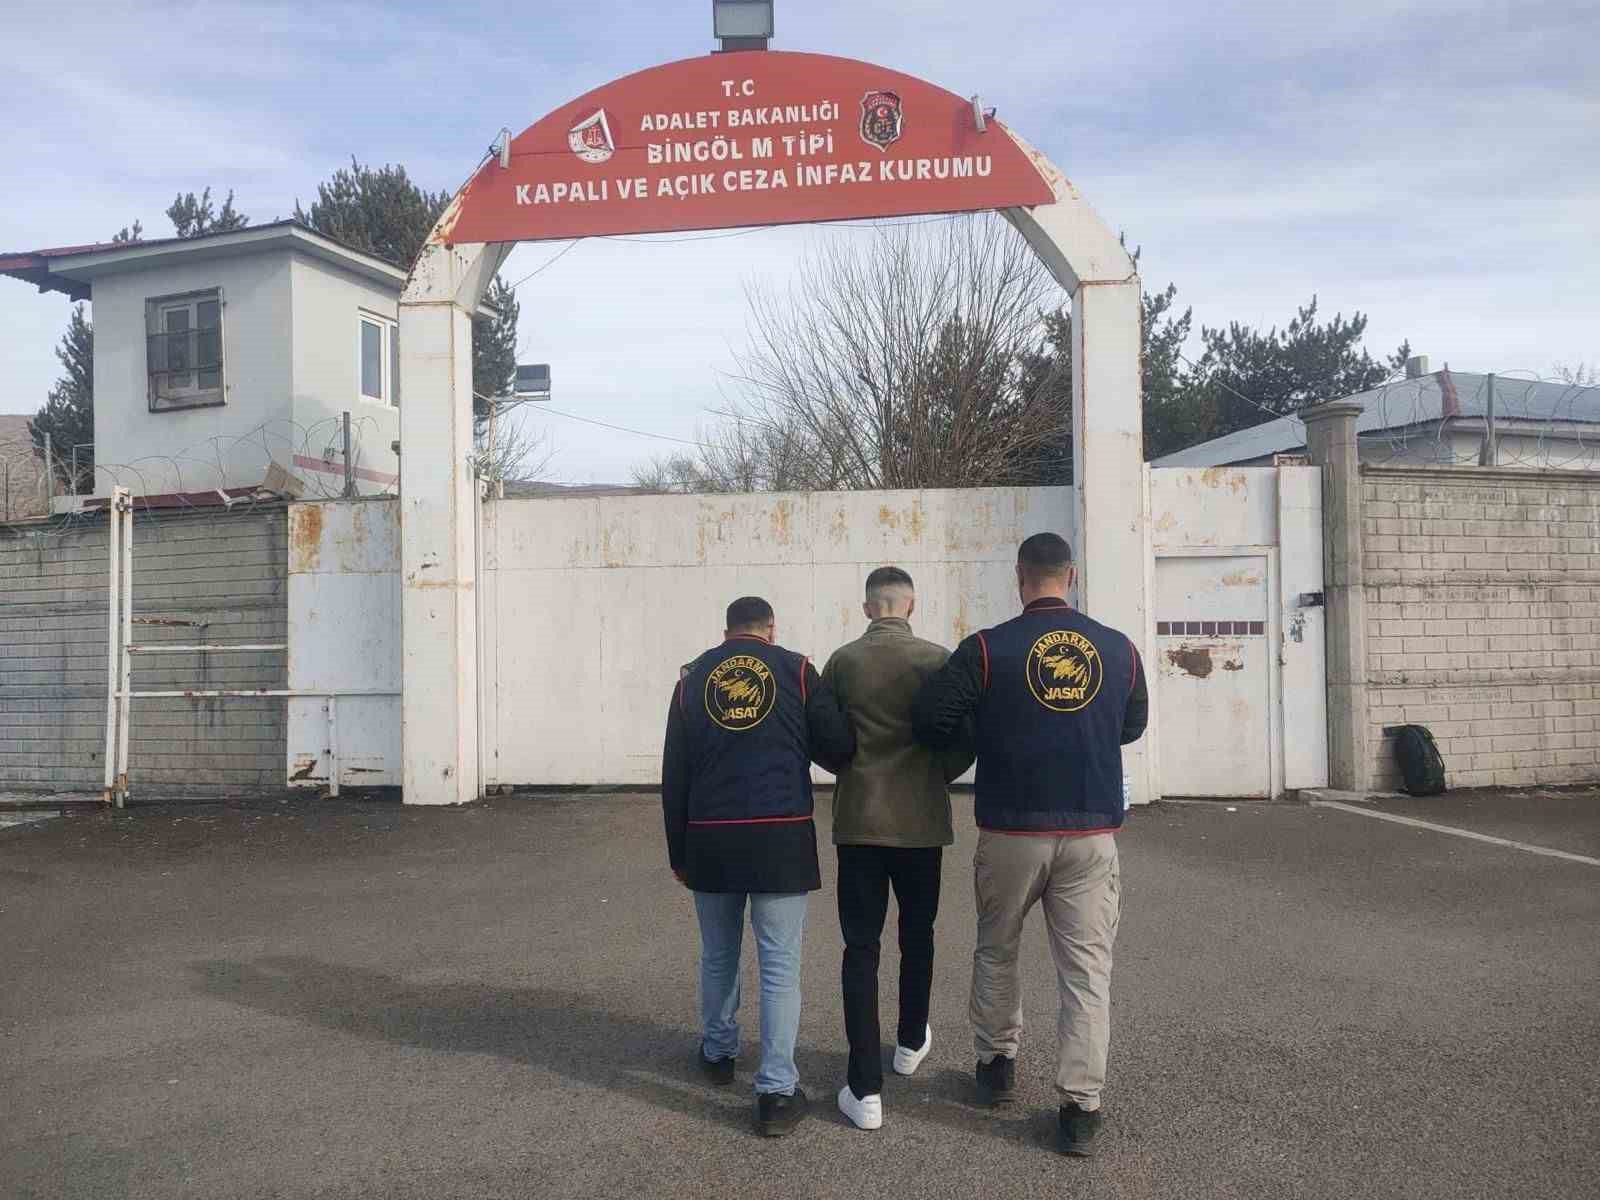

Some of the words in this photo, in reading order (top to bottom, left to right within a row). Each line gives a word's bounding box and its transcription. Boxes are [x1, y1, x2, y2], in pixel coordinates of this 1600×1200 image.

[721, 79, 755, 97] T.C
[640, 111, 721, 132] ADALET
[727, 100, 839, 127] BAKANLIĞI
[647, 136, 744, 164] BİNGÖL
[751, 136, 773, 159] M
[781, 129, 834, 157] TİPİ
[515, 180, 608, 205] KAPALI
[615, 178, 649, 200] VE
[656, 173, 716, 201] AÇIK
[722, 168, 789, 192] CEZA
[796, 161, 873, 187] İNFAZ
[879, 156, 992, 181] KURUMU
[1034, 632, 1095, 658] JANDARMA
[1044, 687, 1086, 700] JASAT
[721, 706, 759, 721] JASAT
